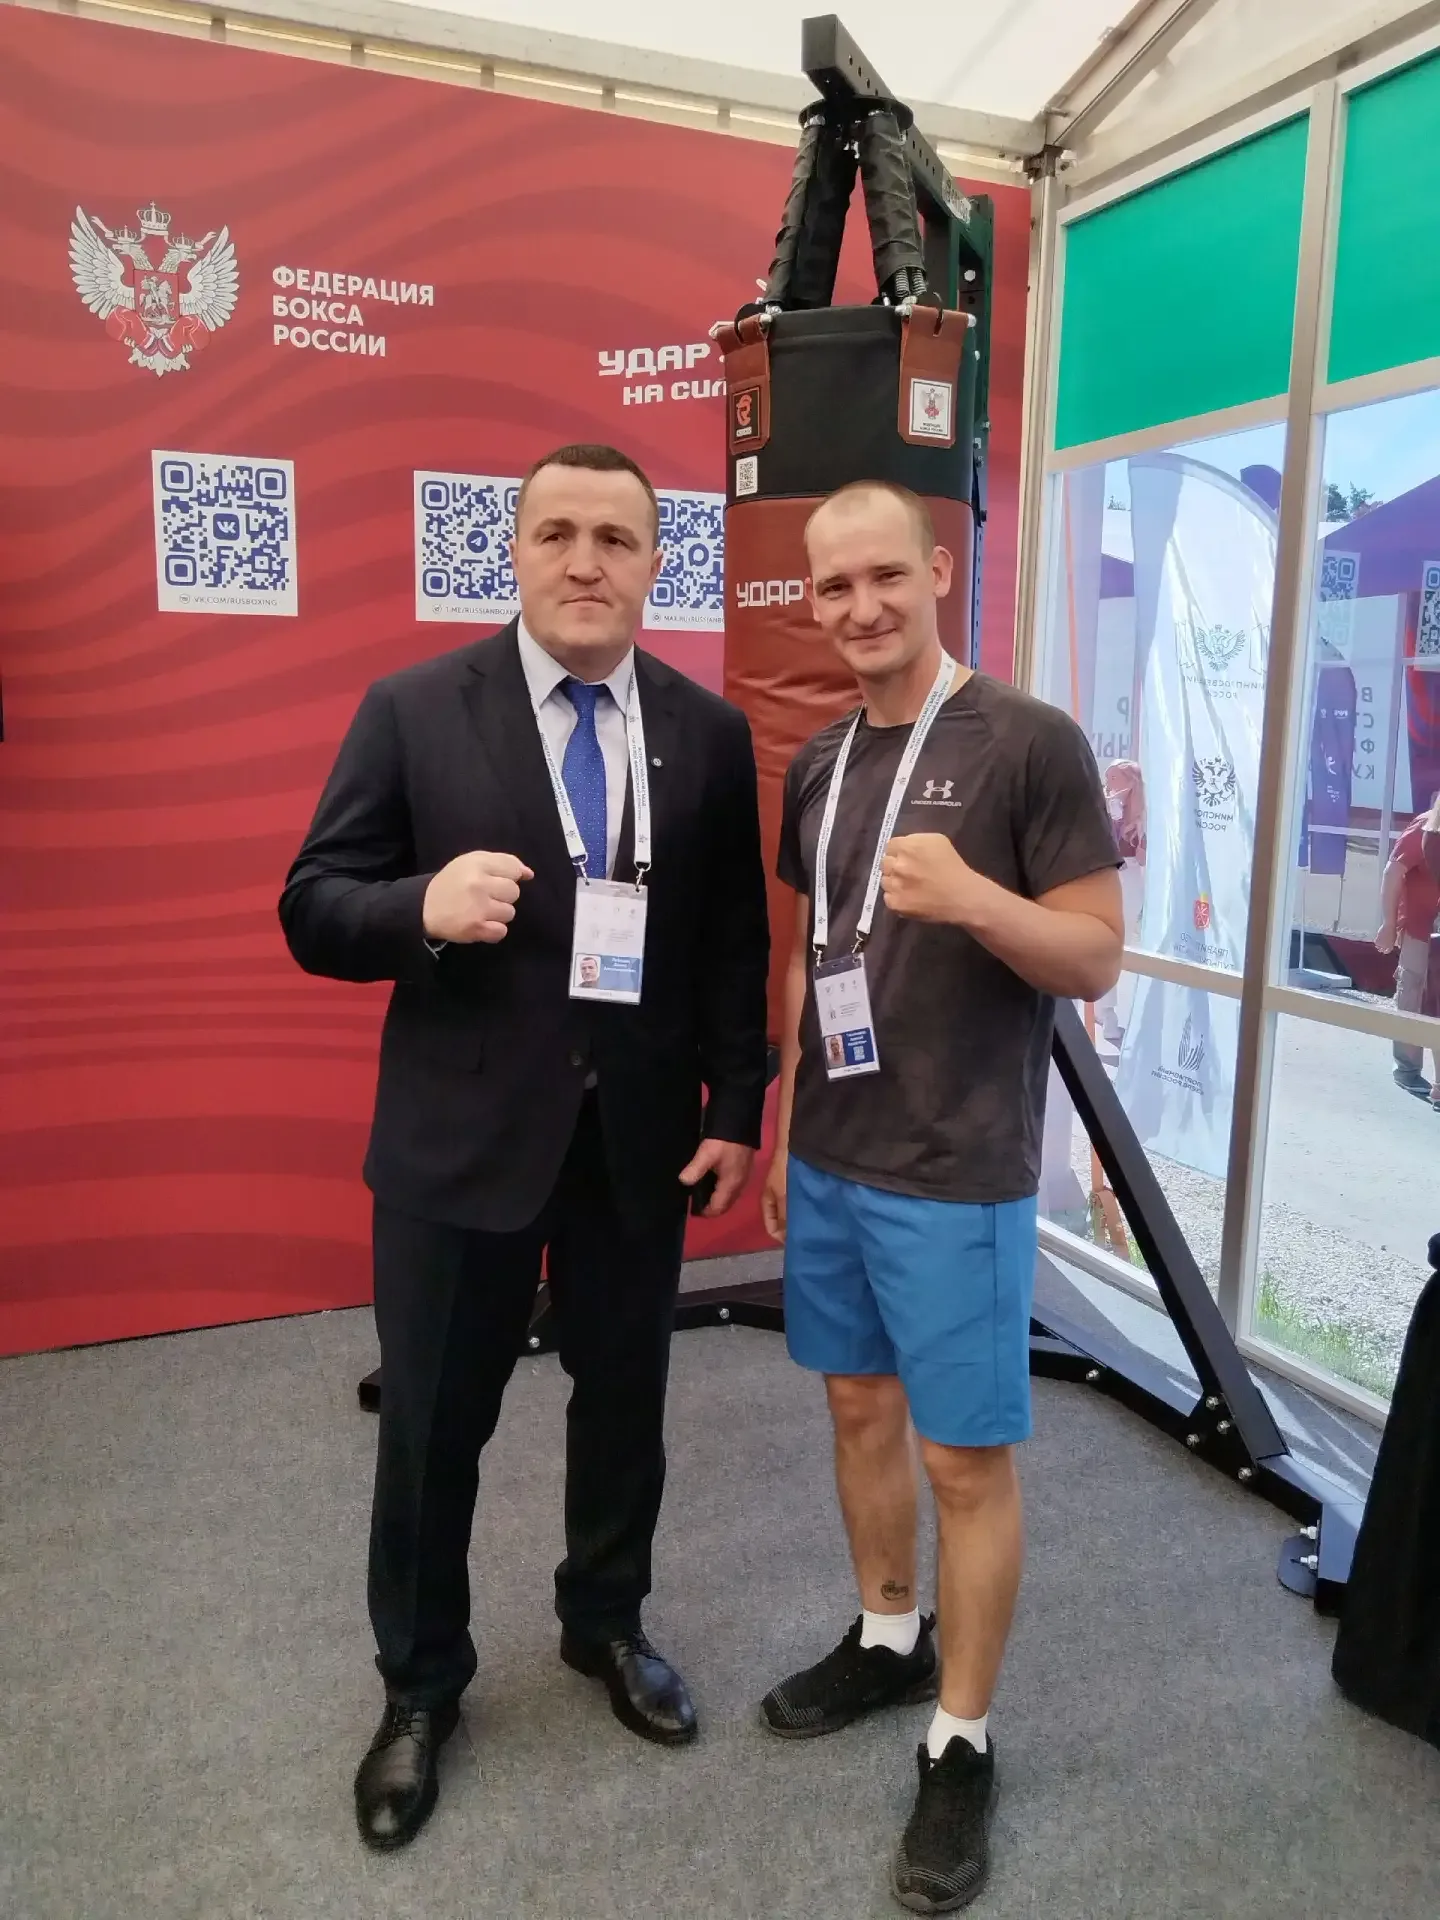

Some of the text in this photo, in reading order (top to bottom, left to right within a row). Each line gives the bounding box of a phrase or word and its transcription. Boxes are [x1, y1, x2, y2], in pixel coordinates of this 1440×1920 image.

[272, 266, 434, 306] ФЕДЕРАЦИЯ
[272, 295, 364, 326] БОКСА
[273, 324, 386, 357] РОССИИ
[599, 343, 711, 378] УДАР
[623, 384, 663, 405] НА
[193, 596, 278, 606] VK.COM/RUSBOXING
[736, 580, 804, 608] УДАР
